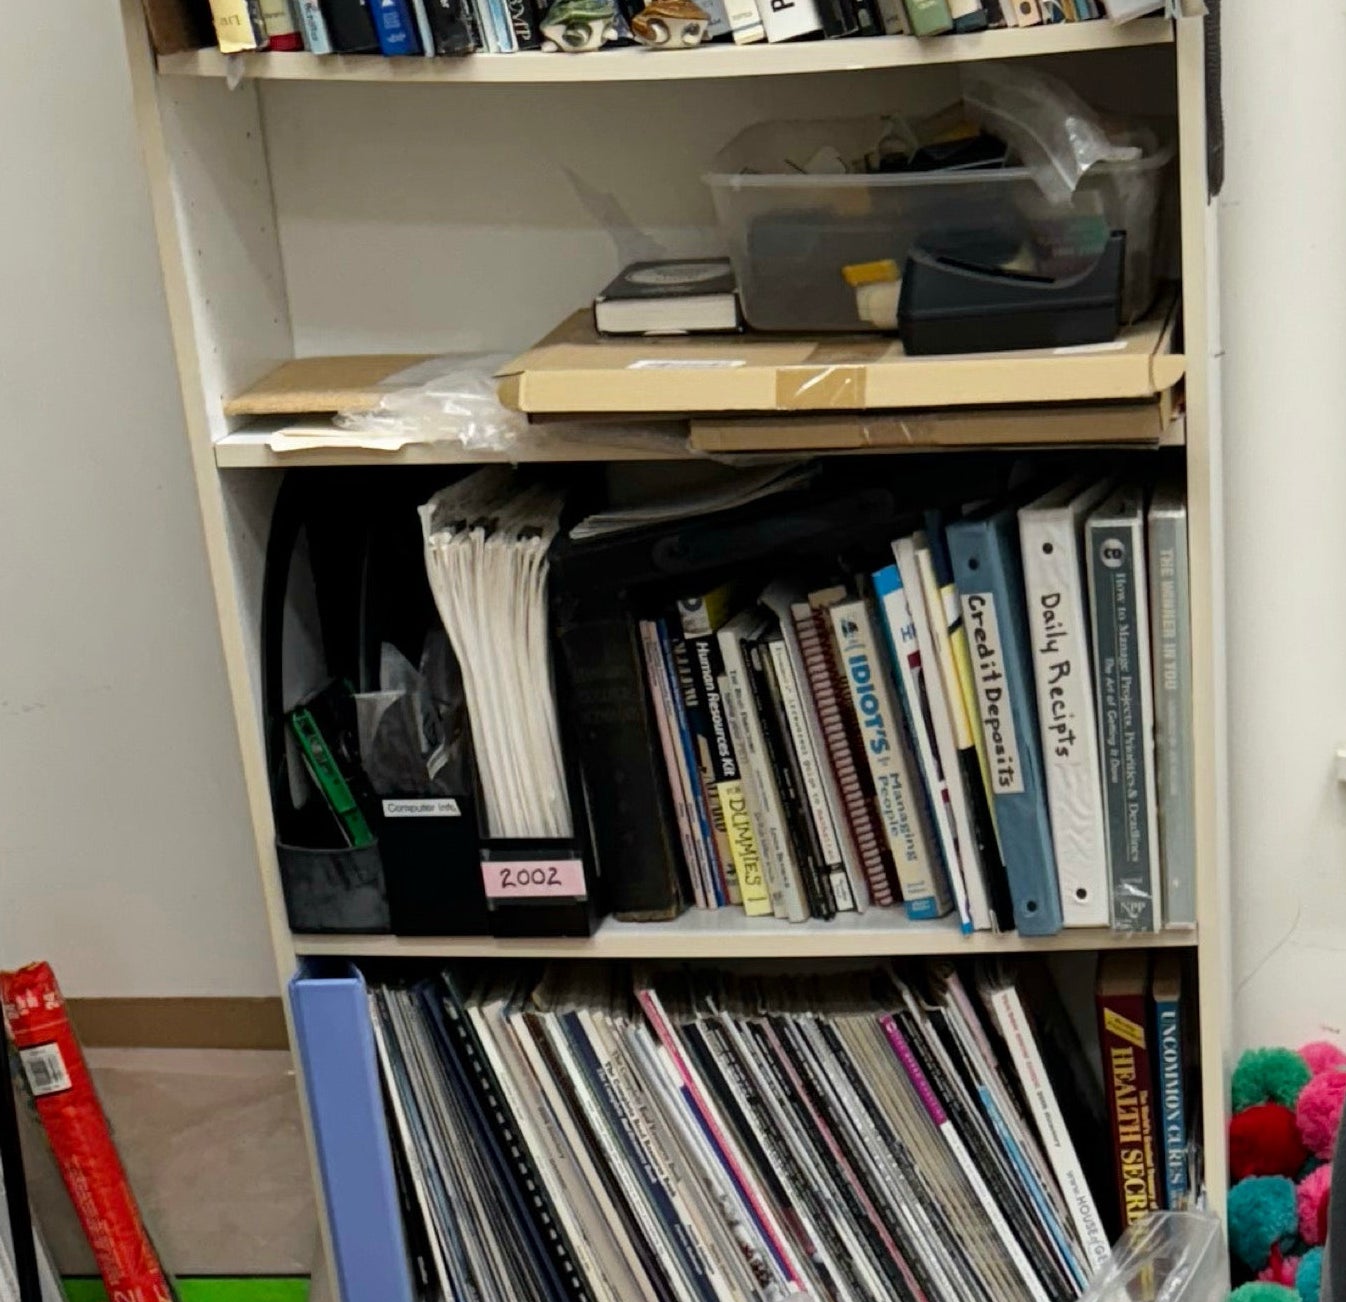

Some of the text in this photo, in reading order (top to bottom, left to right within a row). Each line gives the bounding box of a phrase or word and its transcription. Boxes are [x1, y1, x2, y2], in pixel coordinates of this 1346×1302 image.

[1115, 573, 1128, 599] How
[1160, 550, 1174, 576] THE
[1116, 606, 1128, 620] to
[1160, 582, 1175, 638] WINNER
[1041, 592, 1076, 758] Daily Recipts
[1117, 624, 1131, 670] Manage
[1162, 644, 1176, 659] IN
[848, 654, 892, 755] IDIOT'S
[968, 595, 1016, 787] Credit Deposits
[1164, 664, 1177, 690] YOU
[697, 641, 735, 777] Human Resources Kit
[1111, 759, 1121, 783] Done
[388, 803, 435, 813] Computer
[878, 776, 900, 837] People
[889, 773, 918, 861] Managing
[1127, 803, 1140, 862] Deadlines
[729, 799, 762, 886] DUMMIES
[500, 867, 562, 888] 2002
[1161, 1010, 1181, 1121] UNCOMMON
[1111, 1047, 1141, 1143] HEALTH
[611, 1079, 637, 1117] Complete
[660, 1179, 677, 1198] Book
[1167, 1127, 1186, 1185] CURES
